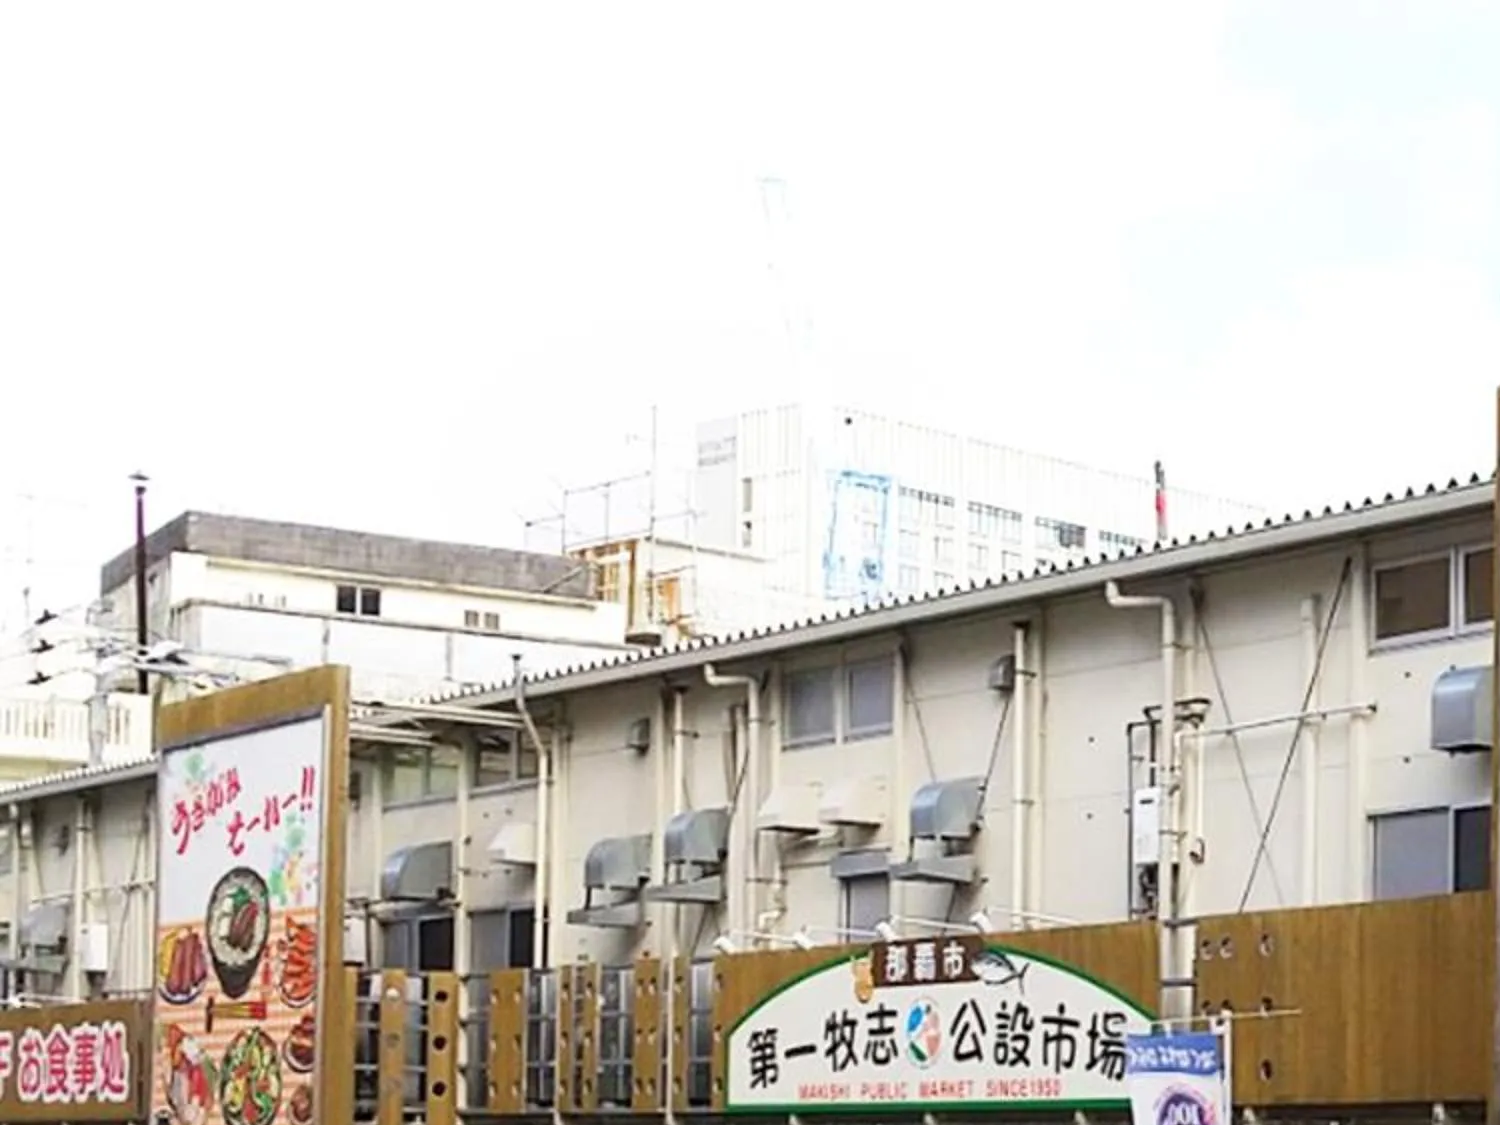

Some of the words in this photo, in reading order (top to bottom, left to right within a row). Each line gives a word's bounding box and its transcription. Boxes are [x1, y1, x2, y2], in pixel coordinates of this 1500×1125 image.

[19, 1022, 128, 1101] お食事処
[799, 1083, 850, 1099] MAKISHI
[861, 1082, 908, 1099] PUBLIC
[919, 1080, 974, 1098] MARKET
